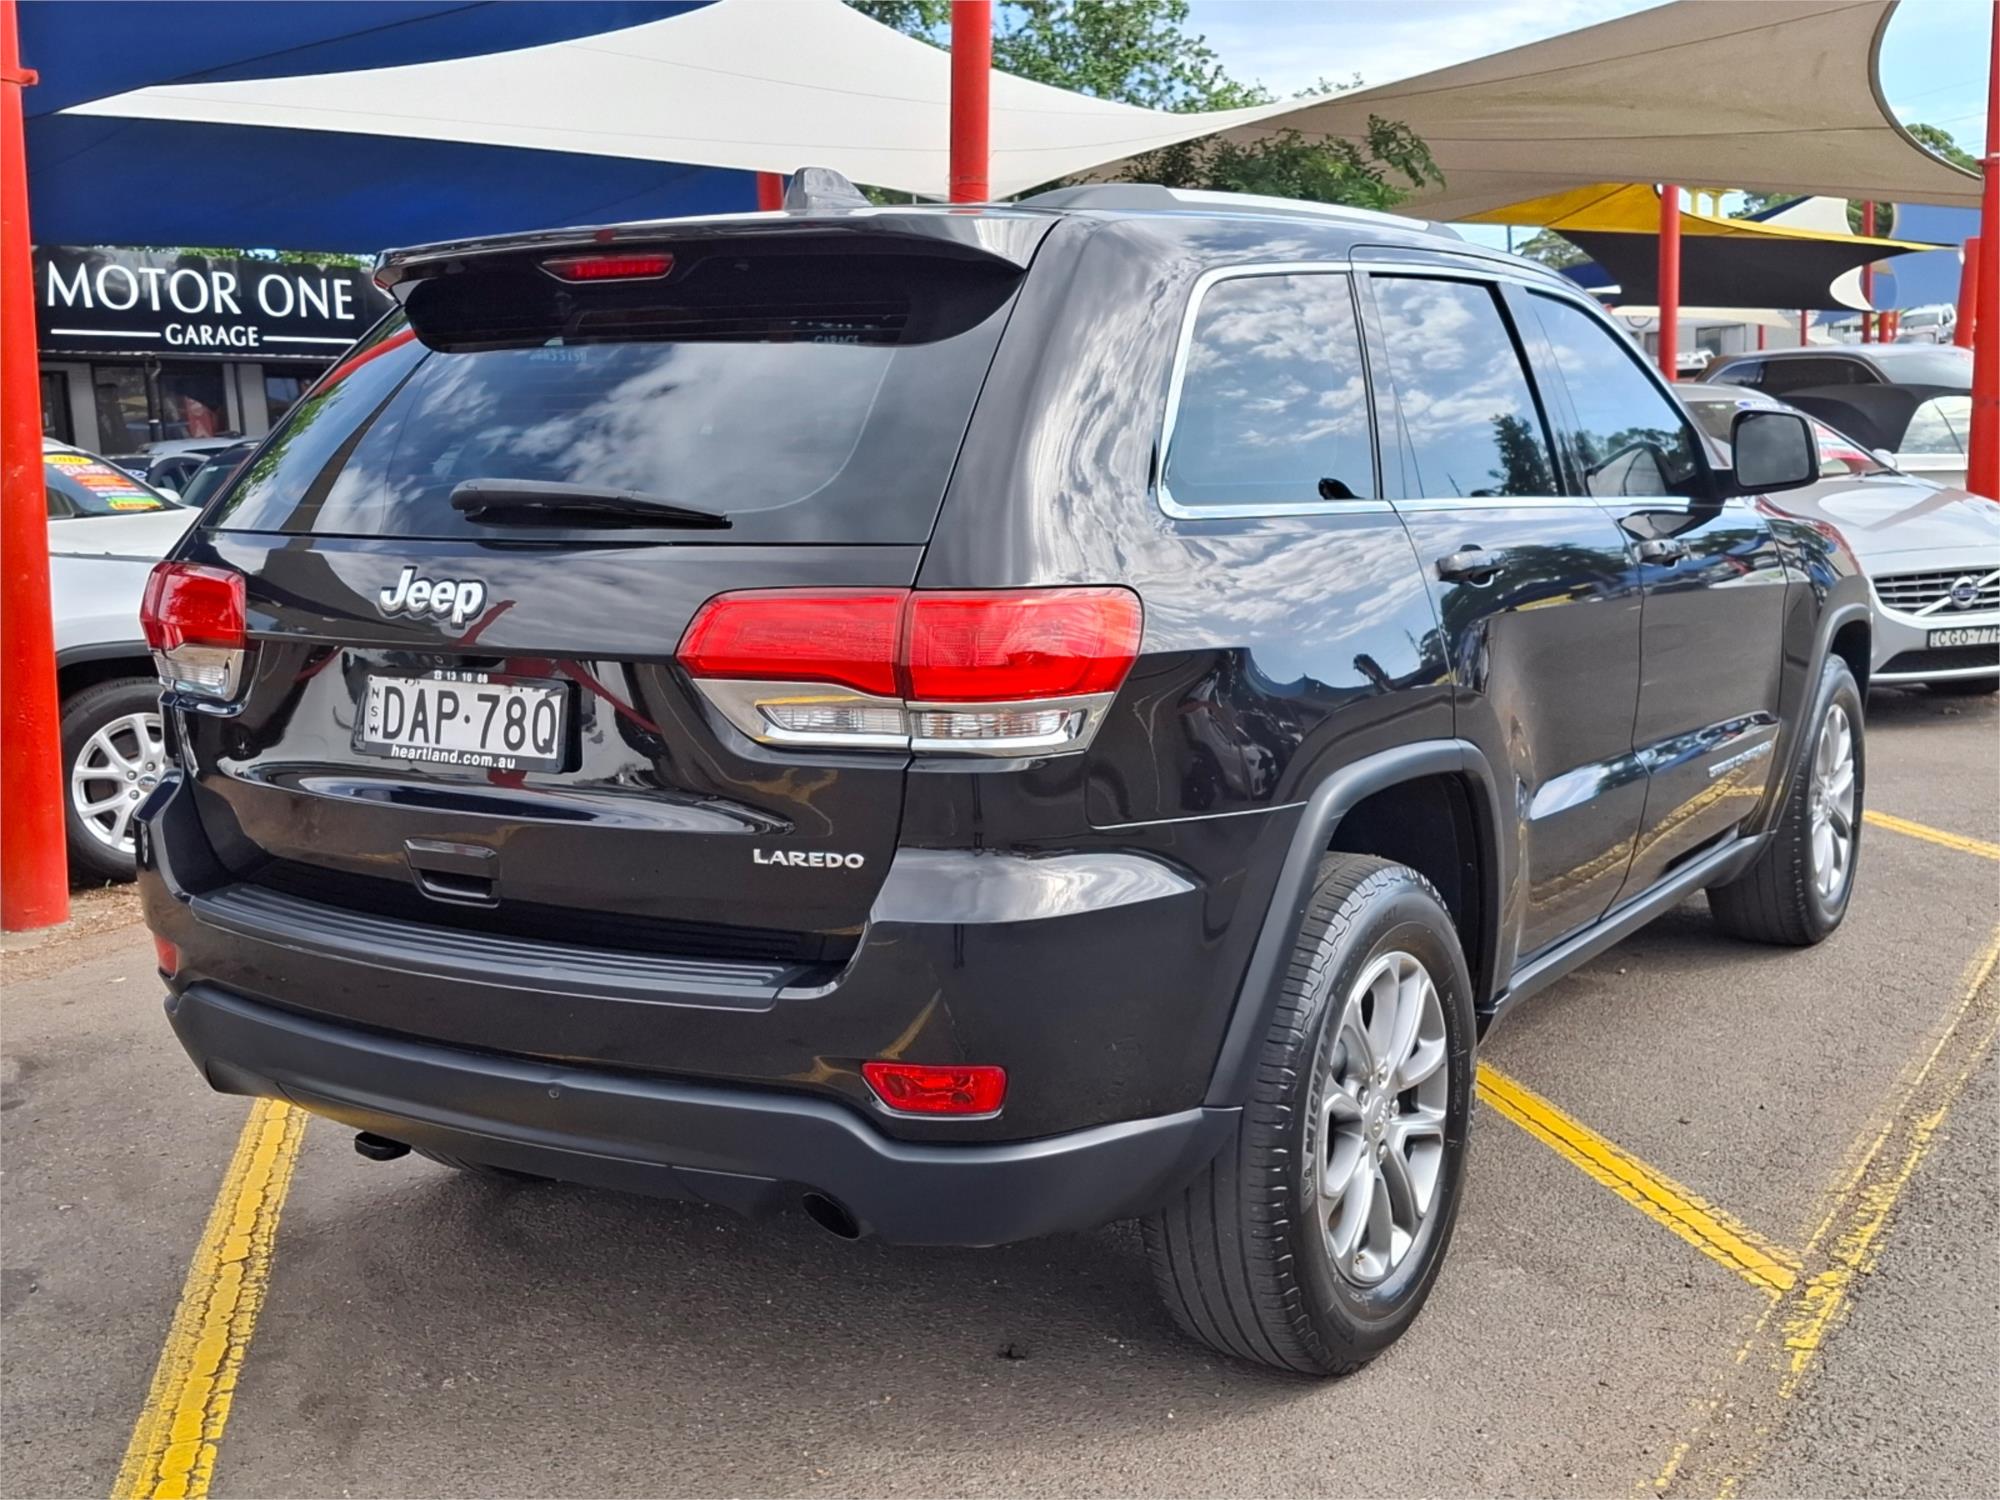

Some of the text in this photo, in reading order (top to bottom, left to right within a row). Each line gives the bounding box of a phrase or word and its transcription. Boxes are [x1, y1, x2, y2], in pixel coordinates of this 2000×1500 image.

[48, 261, 355, 320] MOTOR ONE
[165, 323, 260, 347] GARAGE
[381, 566, 487, 630] Jeep
[447, 670, 457, 681] 13
[462, 671, 472, 682] 10
[391, 744, 516, 769] heartland.com.au
[753, 848, 865, 869] LAREDO
